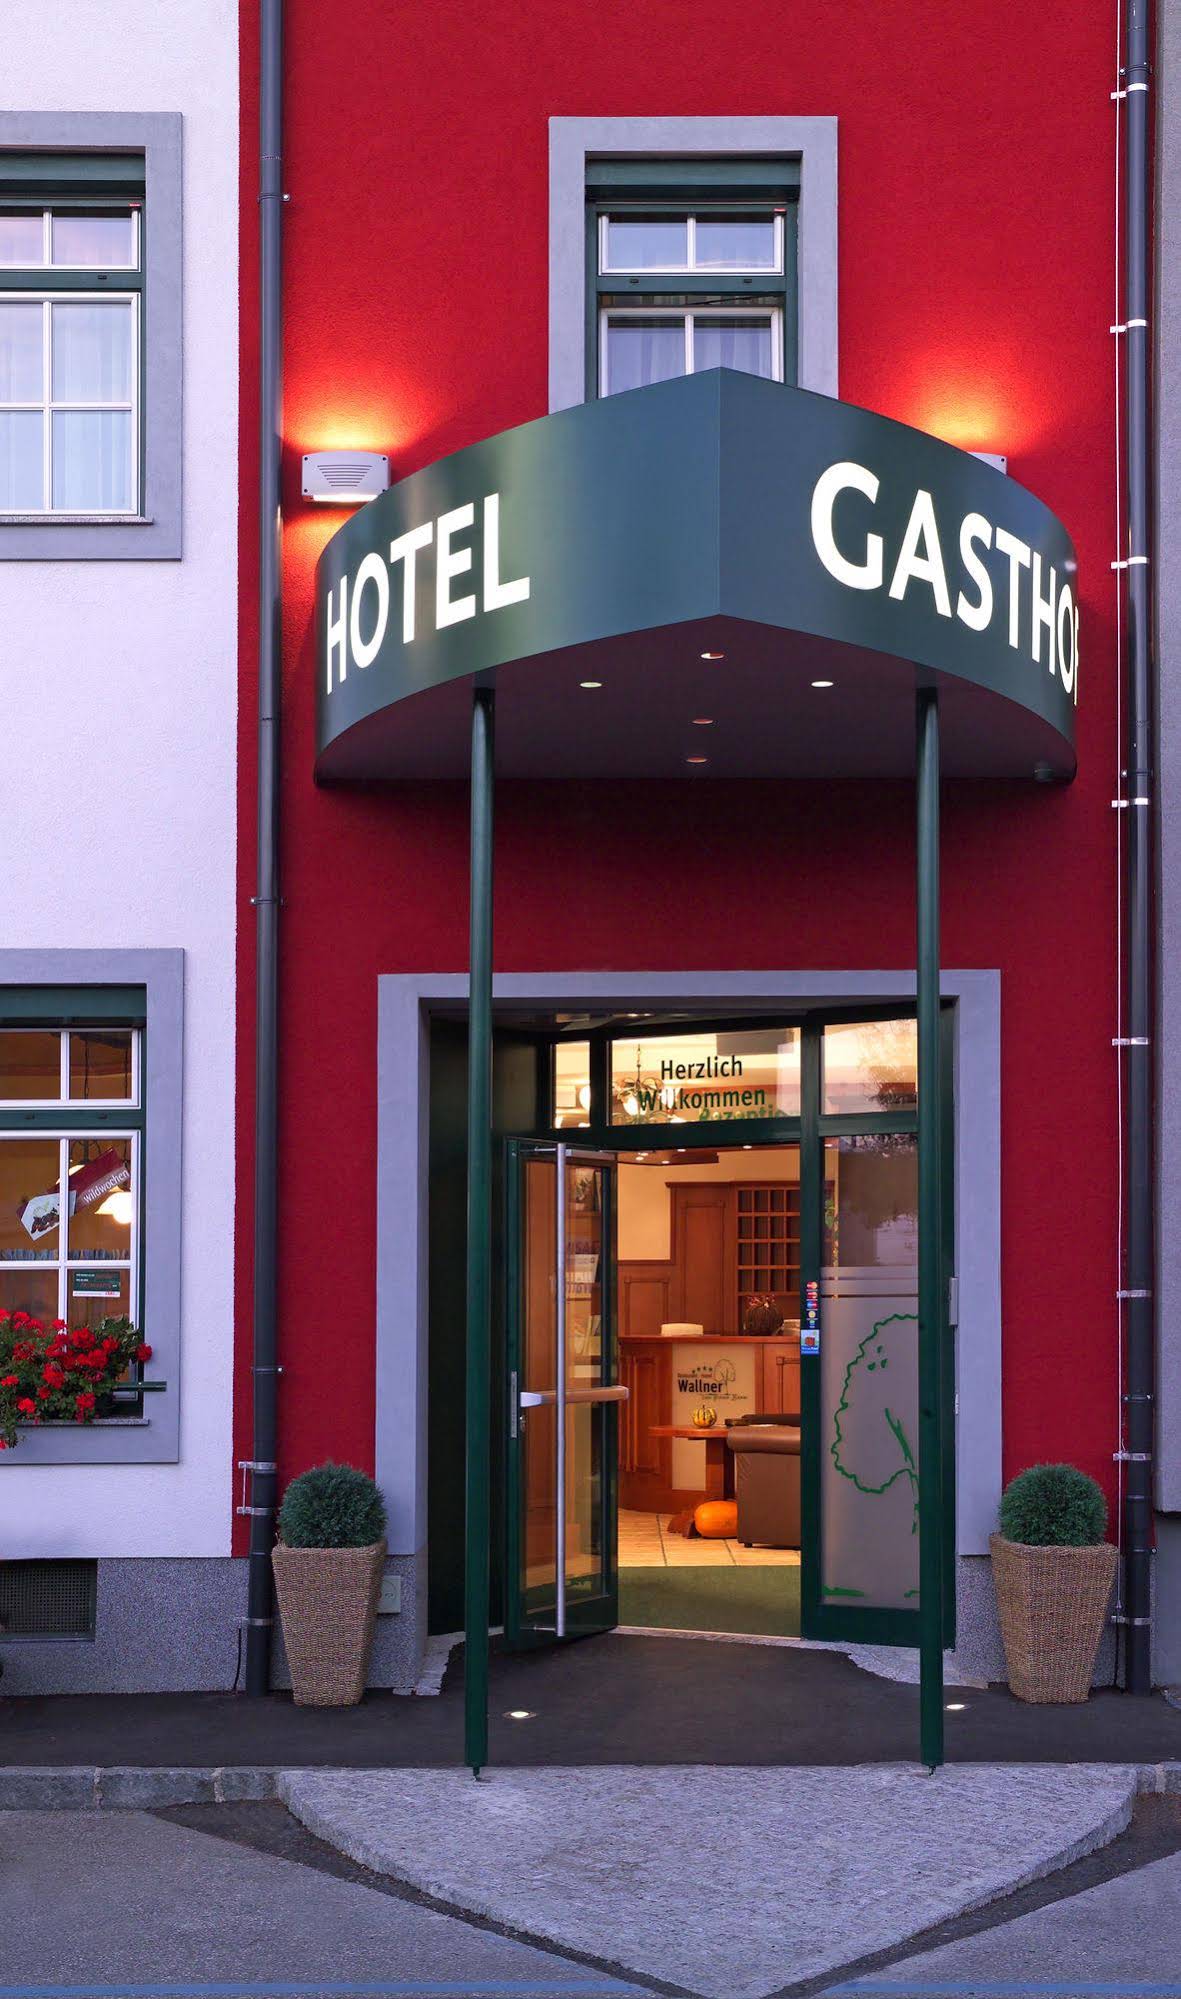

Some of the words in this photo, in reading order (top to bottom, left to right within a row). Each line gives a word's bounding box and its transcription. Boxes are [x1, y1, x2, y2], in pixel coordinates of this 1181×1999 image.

[327, 493, 530, 695] HOTEL
[661, 1055, 743, 1079] Herzlich
[639, 1088, 765, 1111] Willkommen
[678, 1379, 723, 1393] Wallner
